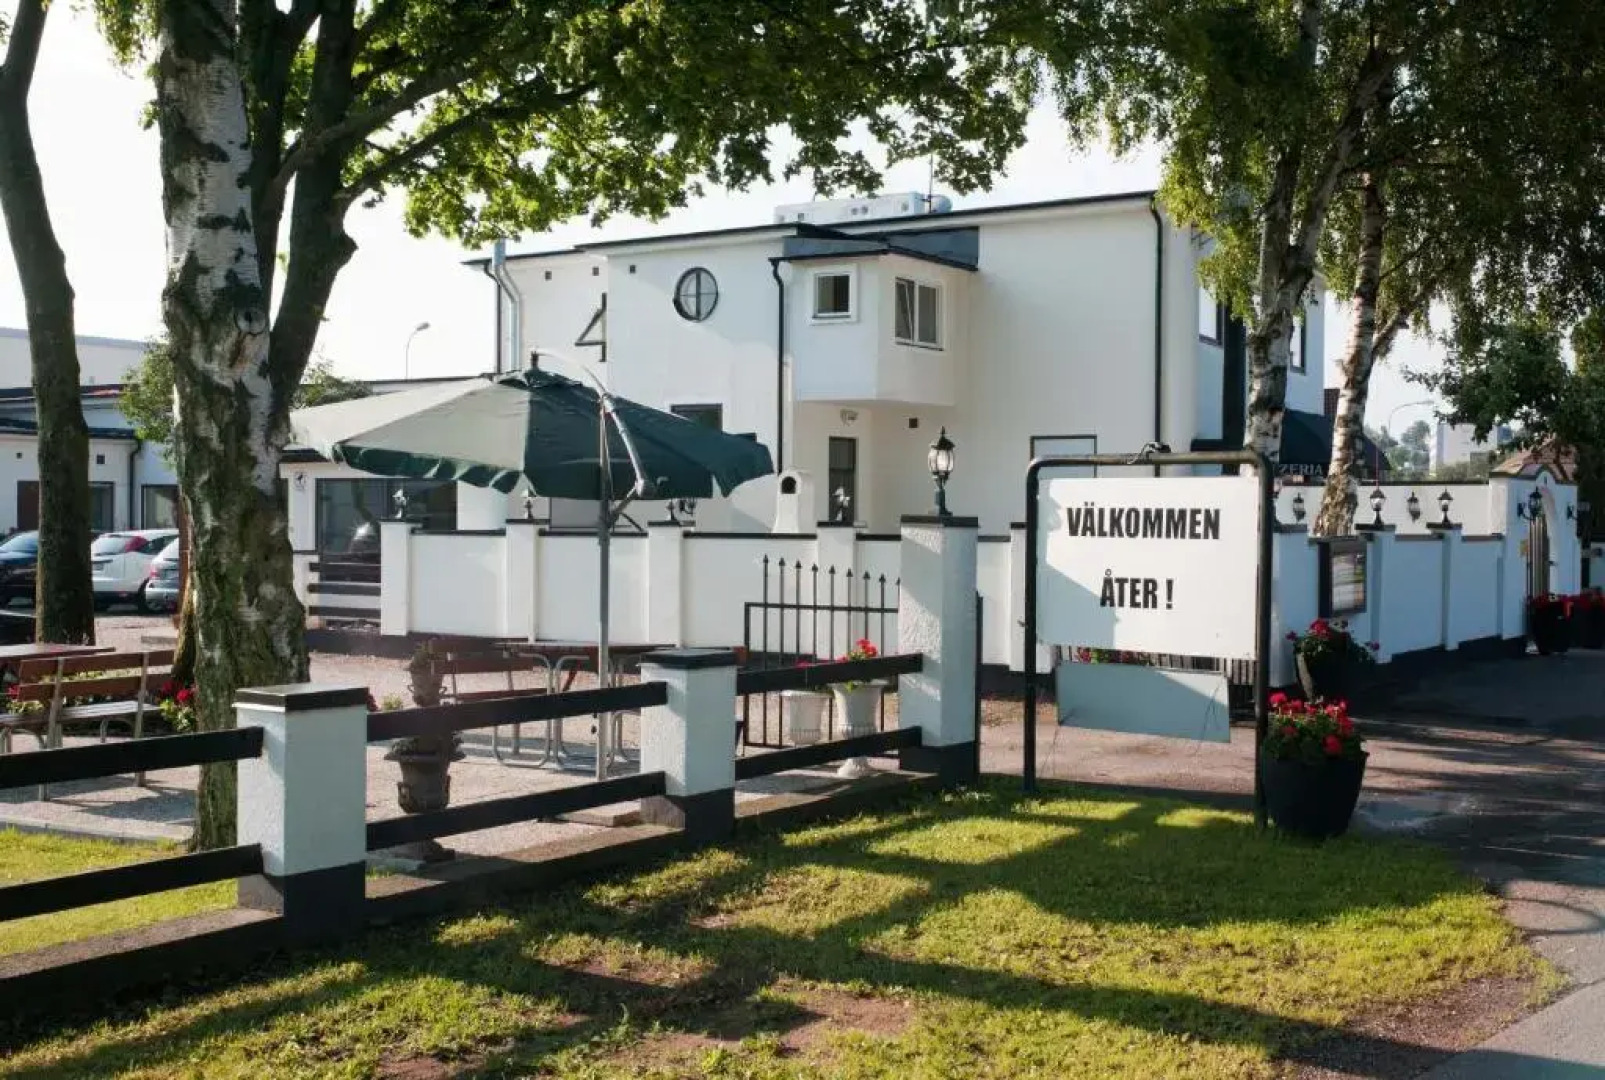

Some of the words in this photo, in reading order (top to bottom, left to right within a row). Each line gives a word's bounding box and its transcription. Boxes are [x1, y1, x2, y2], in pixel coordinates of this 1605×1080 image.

[1277, 463, 1323, 476] ZERIA
[1066, 501, 1221, 540] VÄLKOMMEN
[1099, 568, 1158, 609] ÅTER
